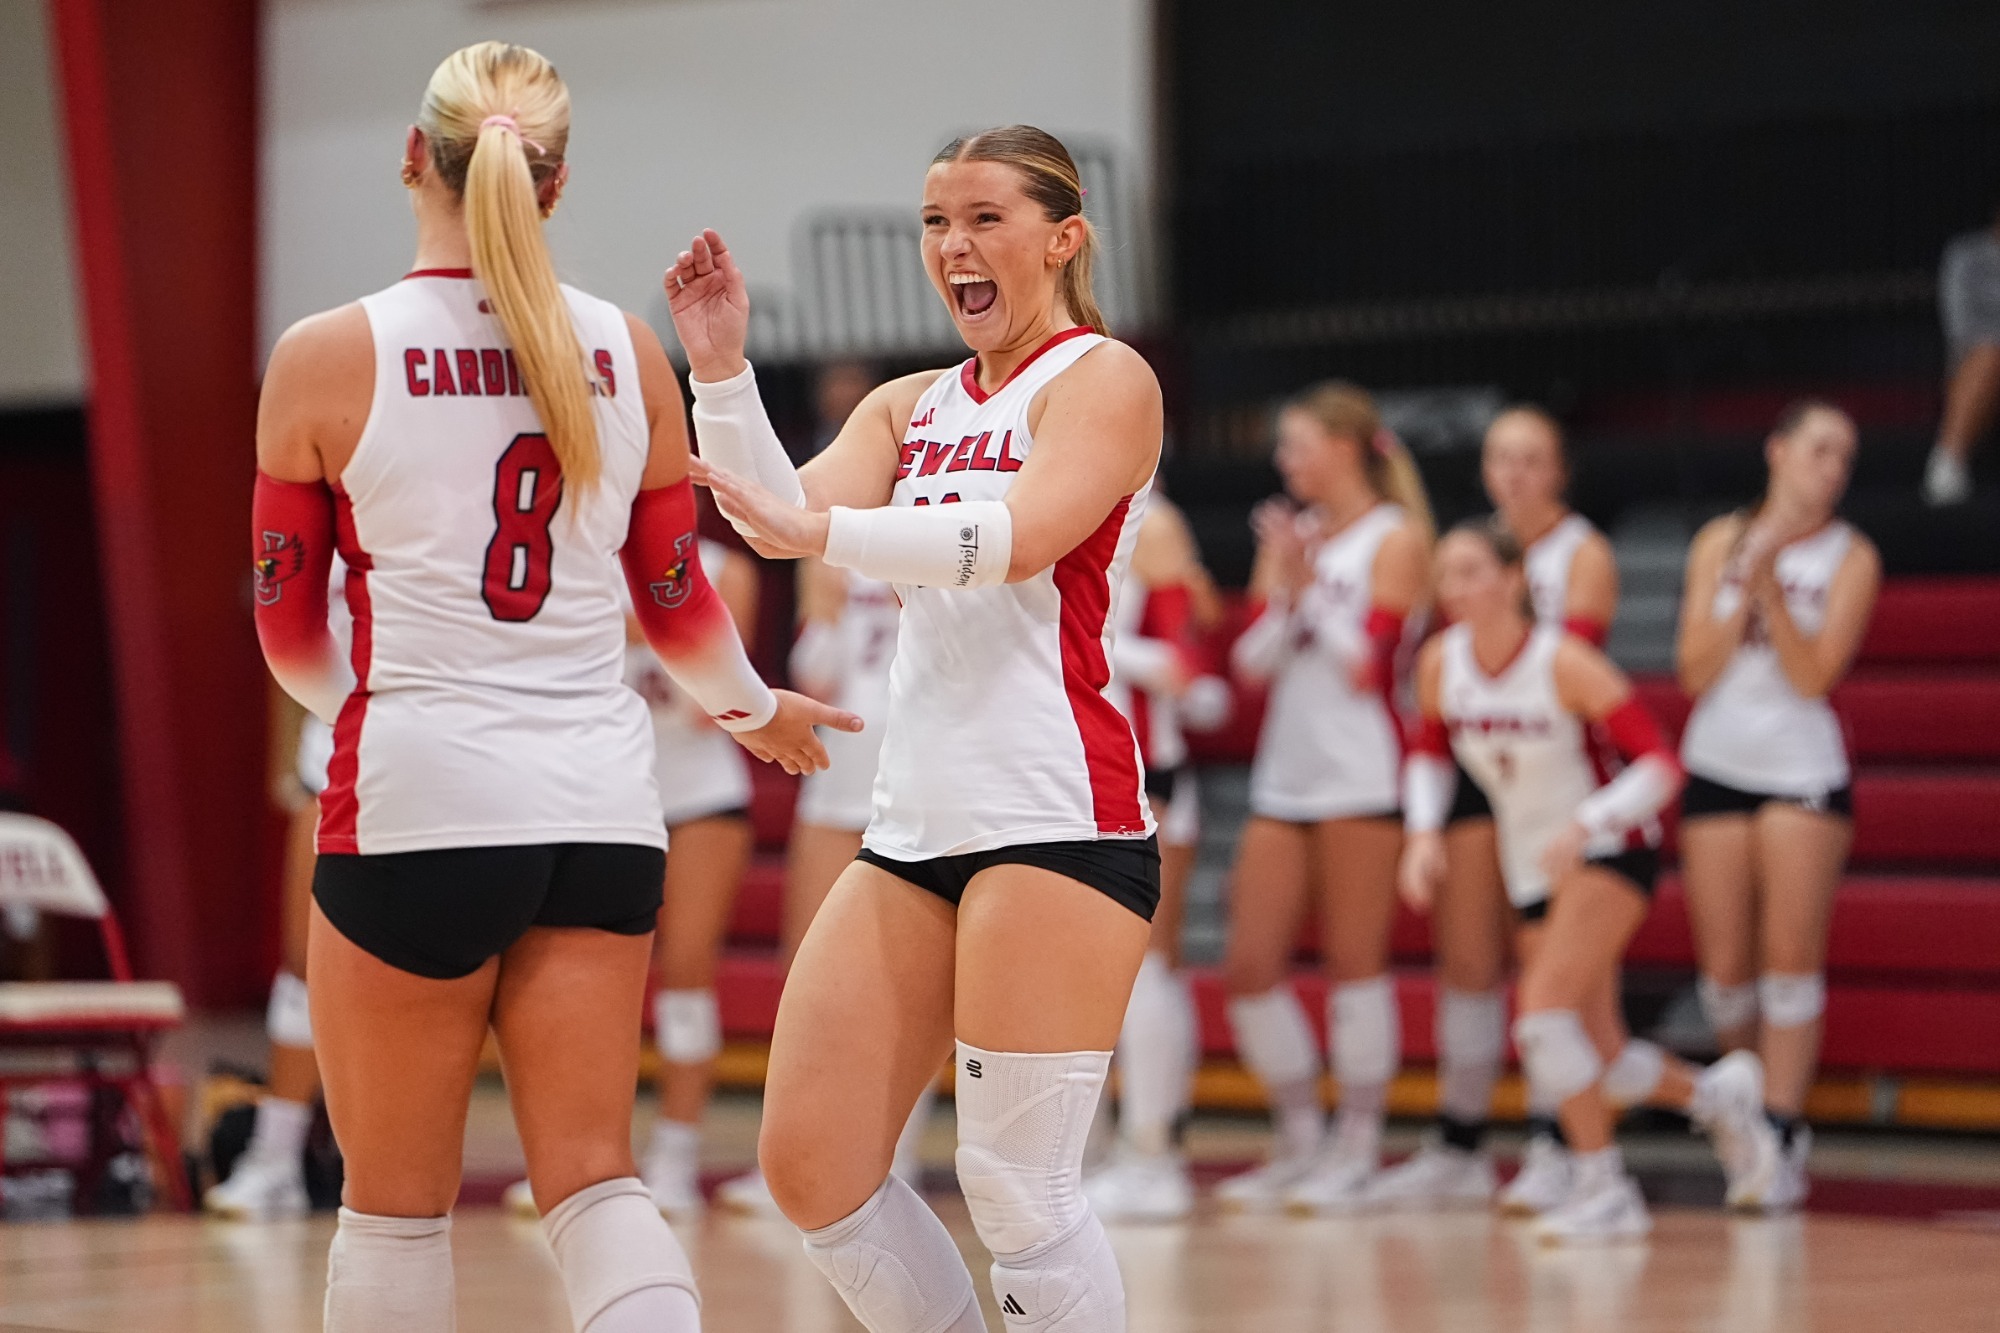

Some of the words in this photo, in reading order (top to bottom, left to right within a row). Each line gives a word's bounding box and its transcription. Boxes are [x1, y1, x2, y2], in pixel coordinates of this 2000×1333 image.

[404, 348, 616, 398] CARDIS
[896, 428, 1024, 482] EWELL
[481, 433, 563, 622] 8
